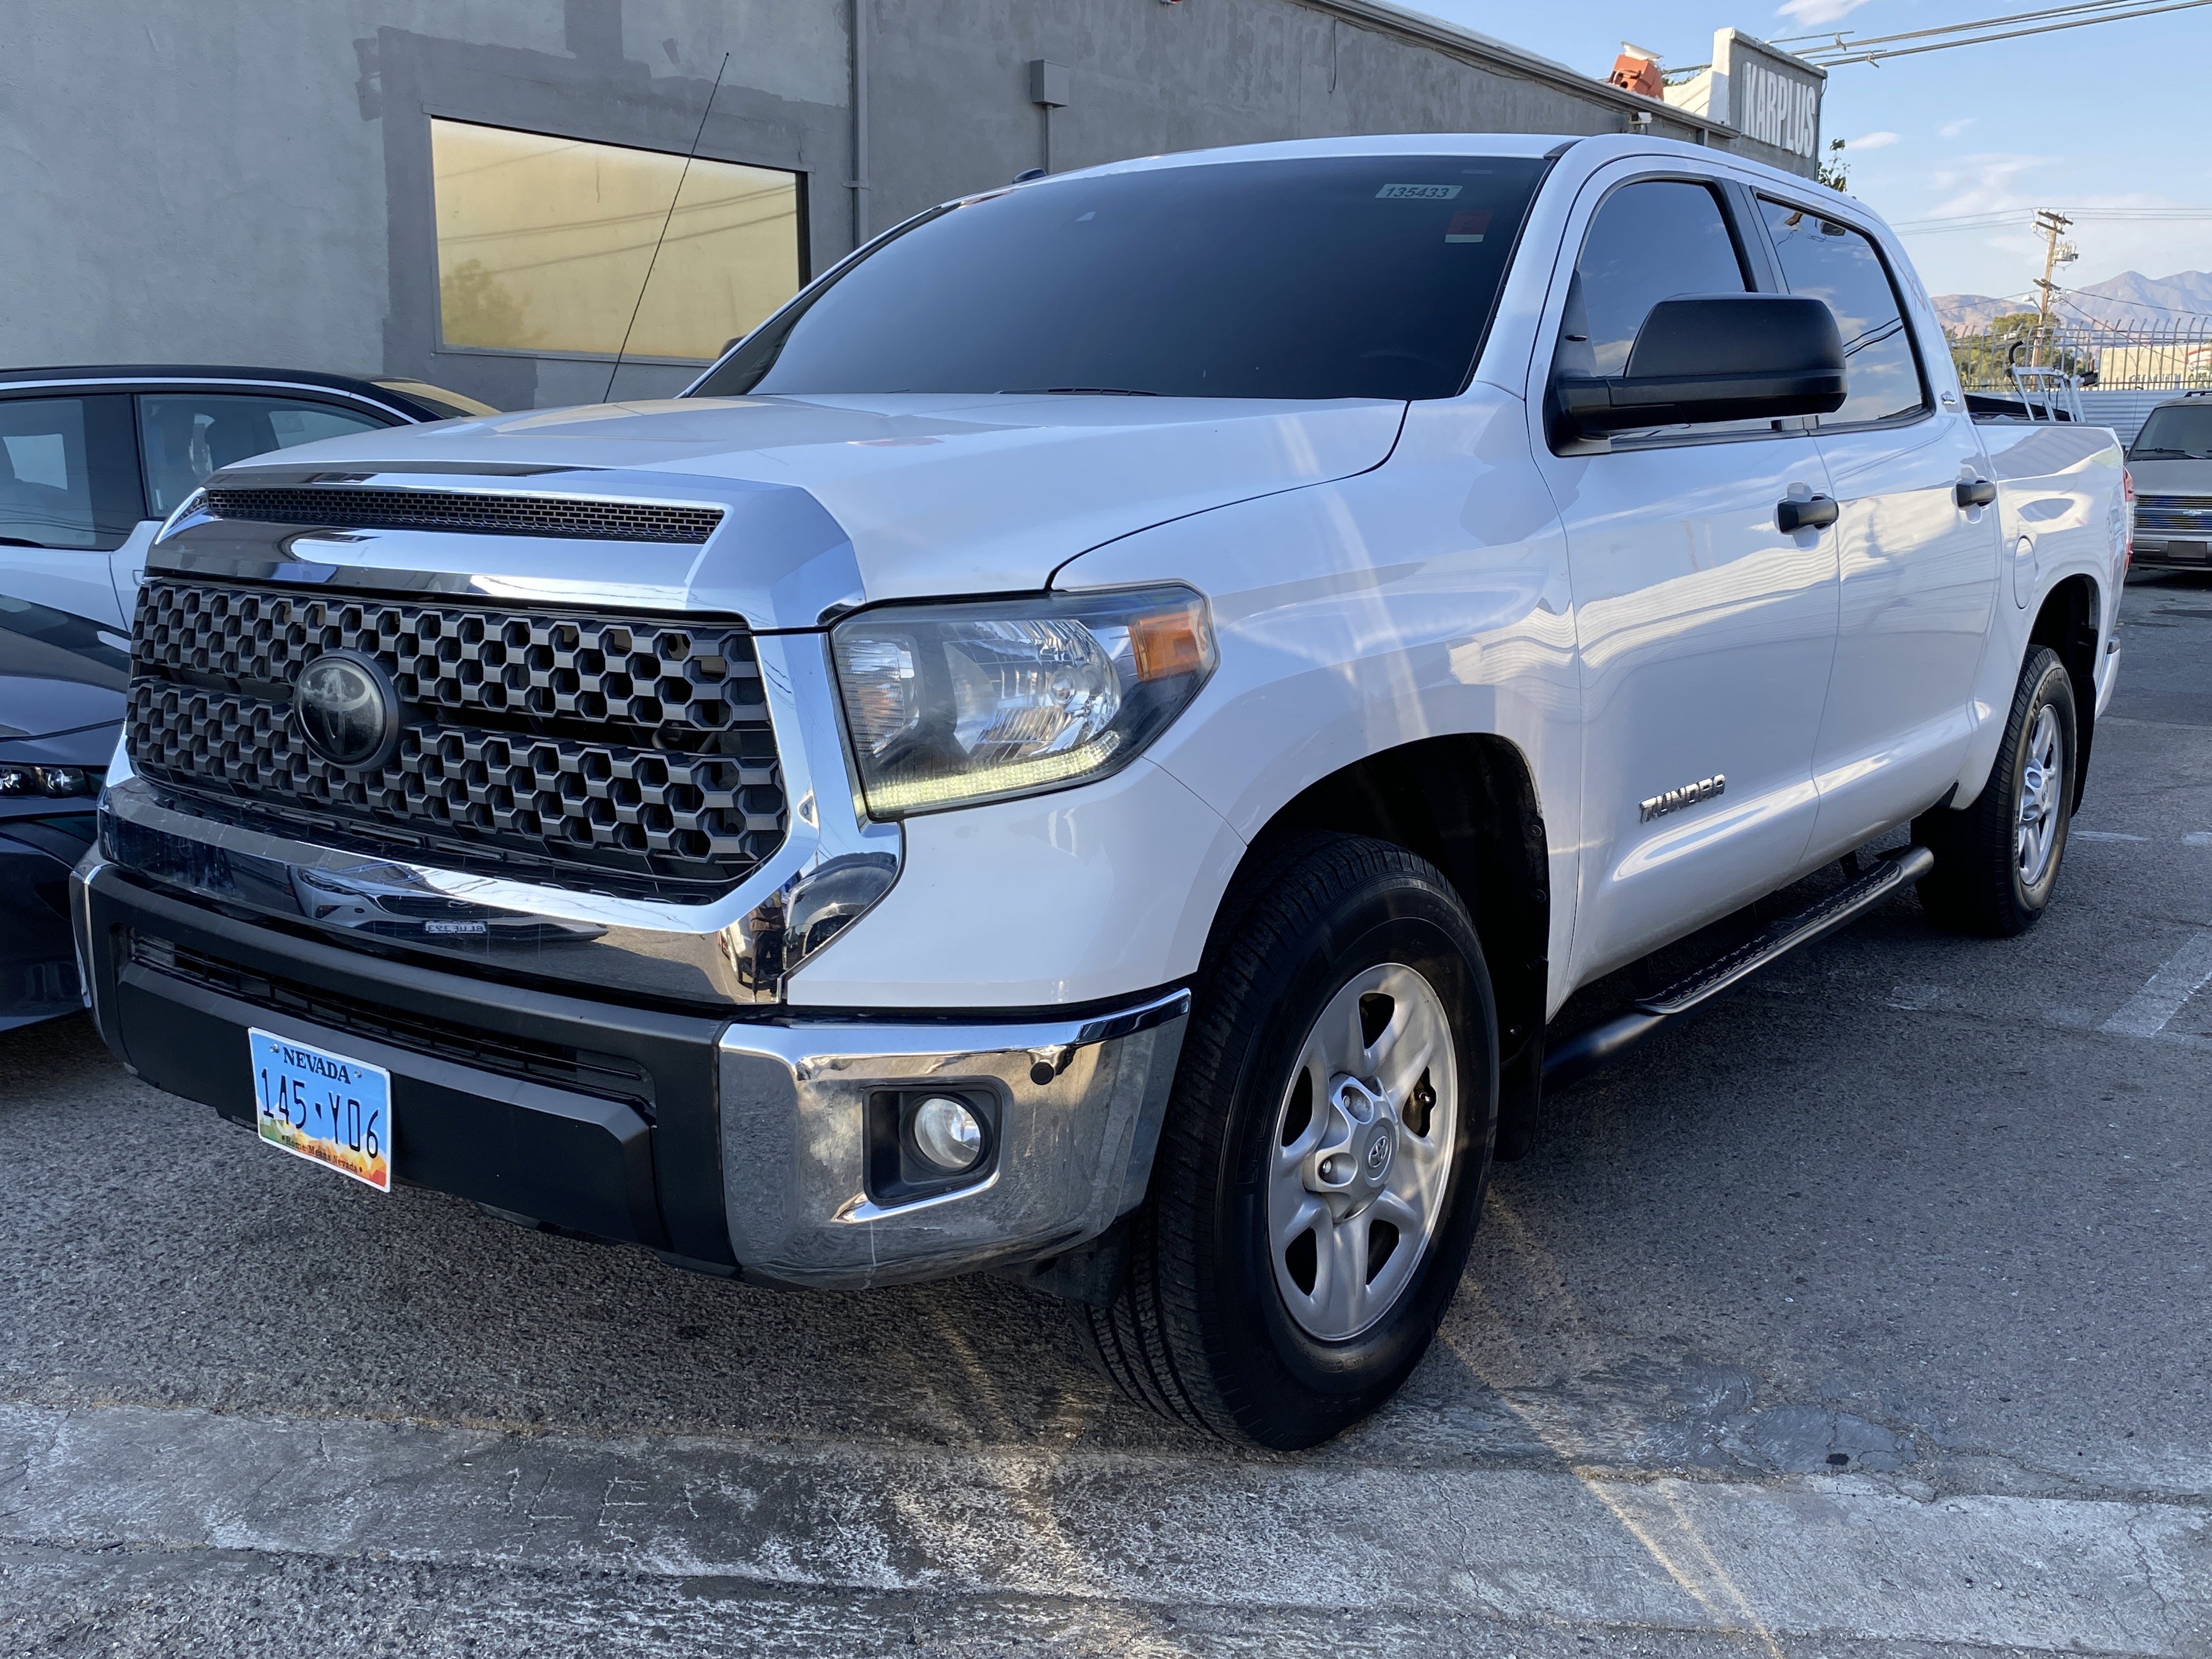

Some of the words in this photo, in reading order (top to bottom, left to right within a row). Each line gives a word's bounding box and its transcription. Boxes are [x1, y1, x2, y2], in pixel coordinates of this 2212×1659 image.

[1741, 61, 1815, 158] KARPLUS
[1386, 187, 1449, 198] 135433
[1639, 773, 1726, 824] TUNDRA
[283, 1047, 351, 1085] NEVADA
[286, 1136, 307, 1152] Home
[308, 1144, 331, 1161] Means
[333, 1155, 358, 1173] Nevada
